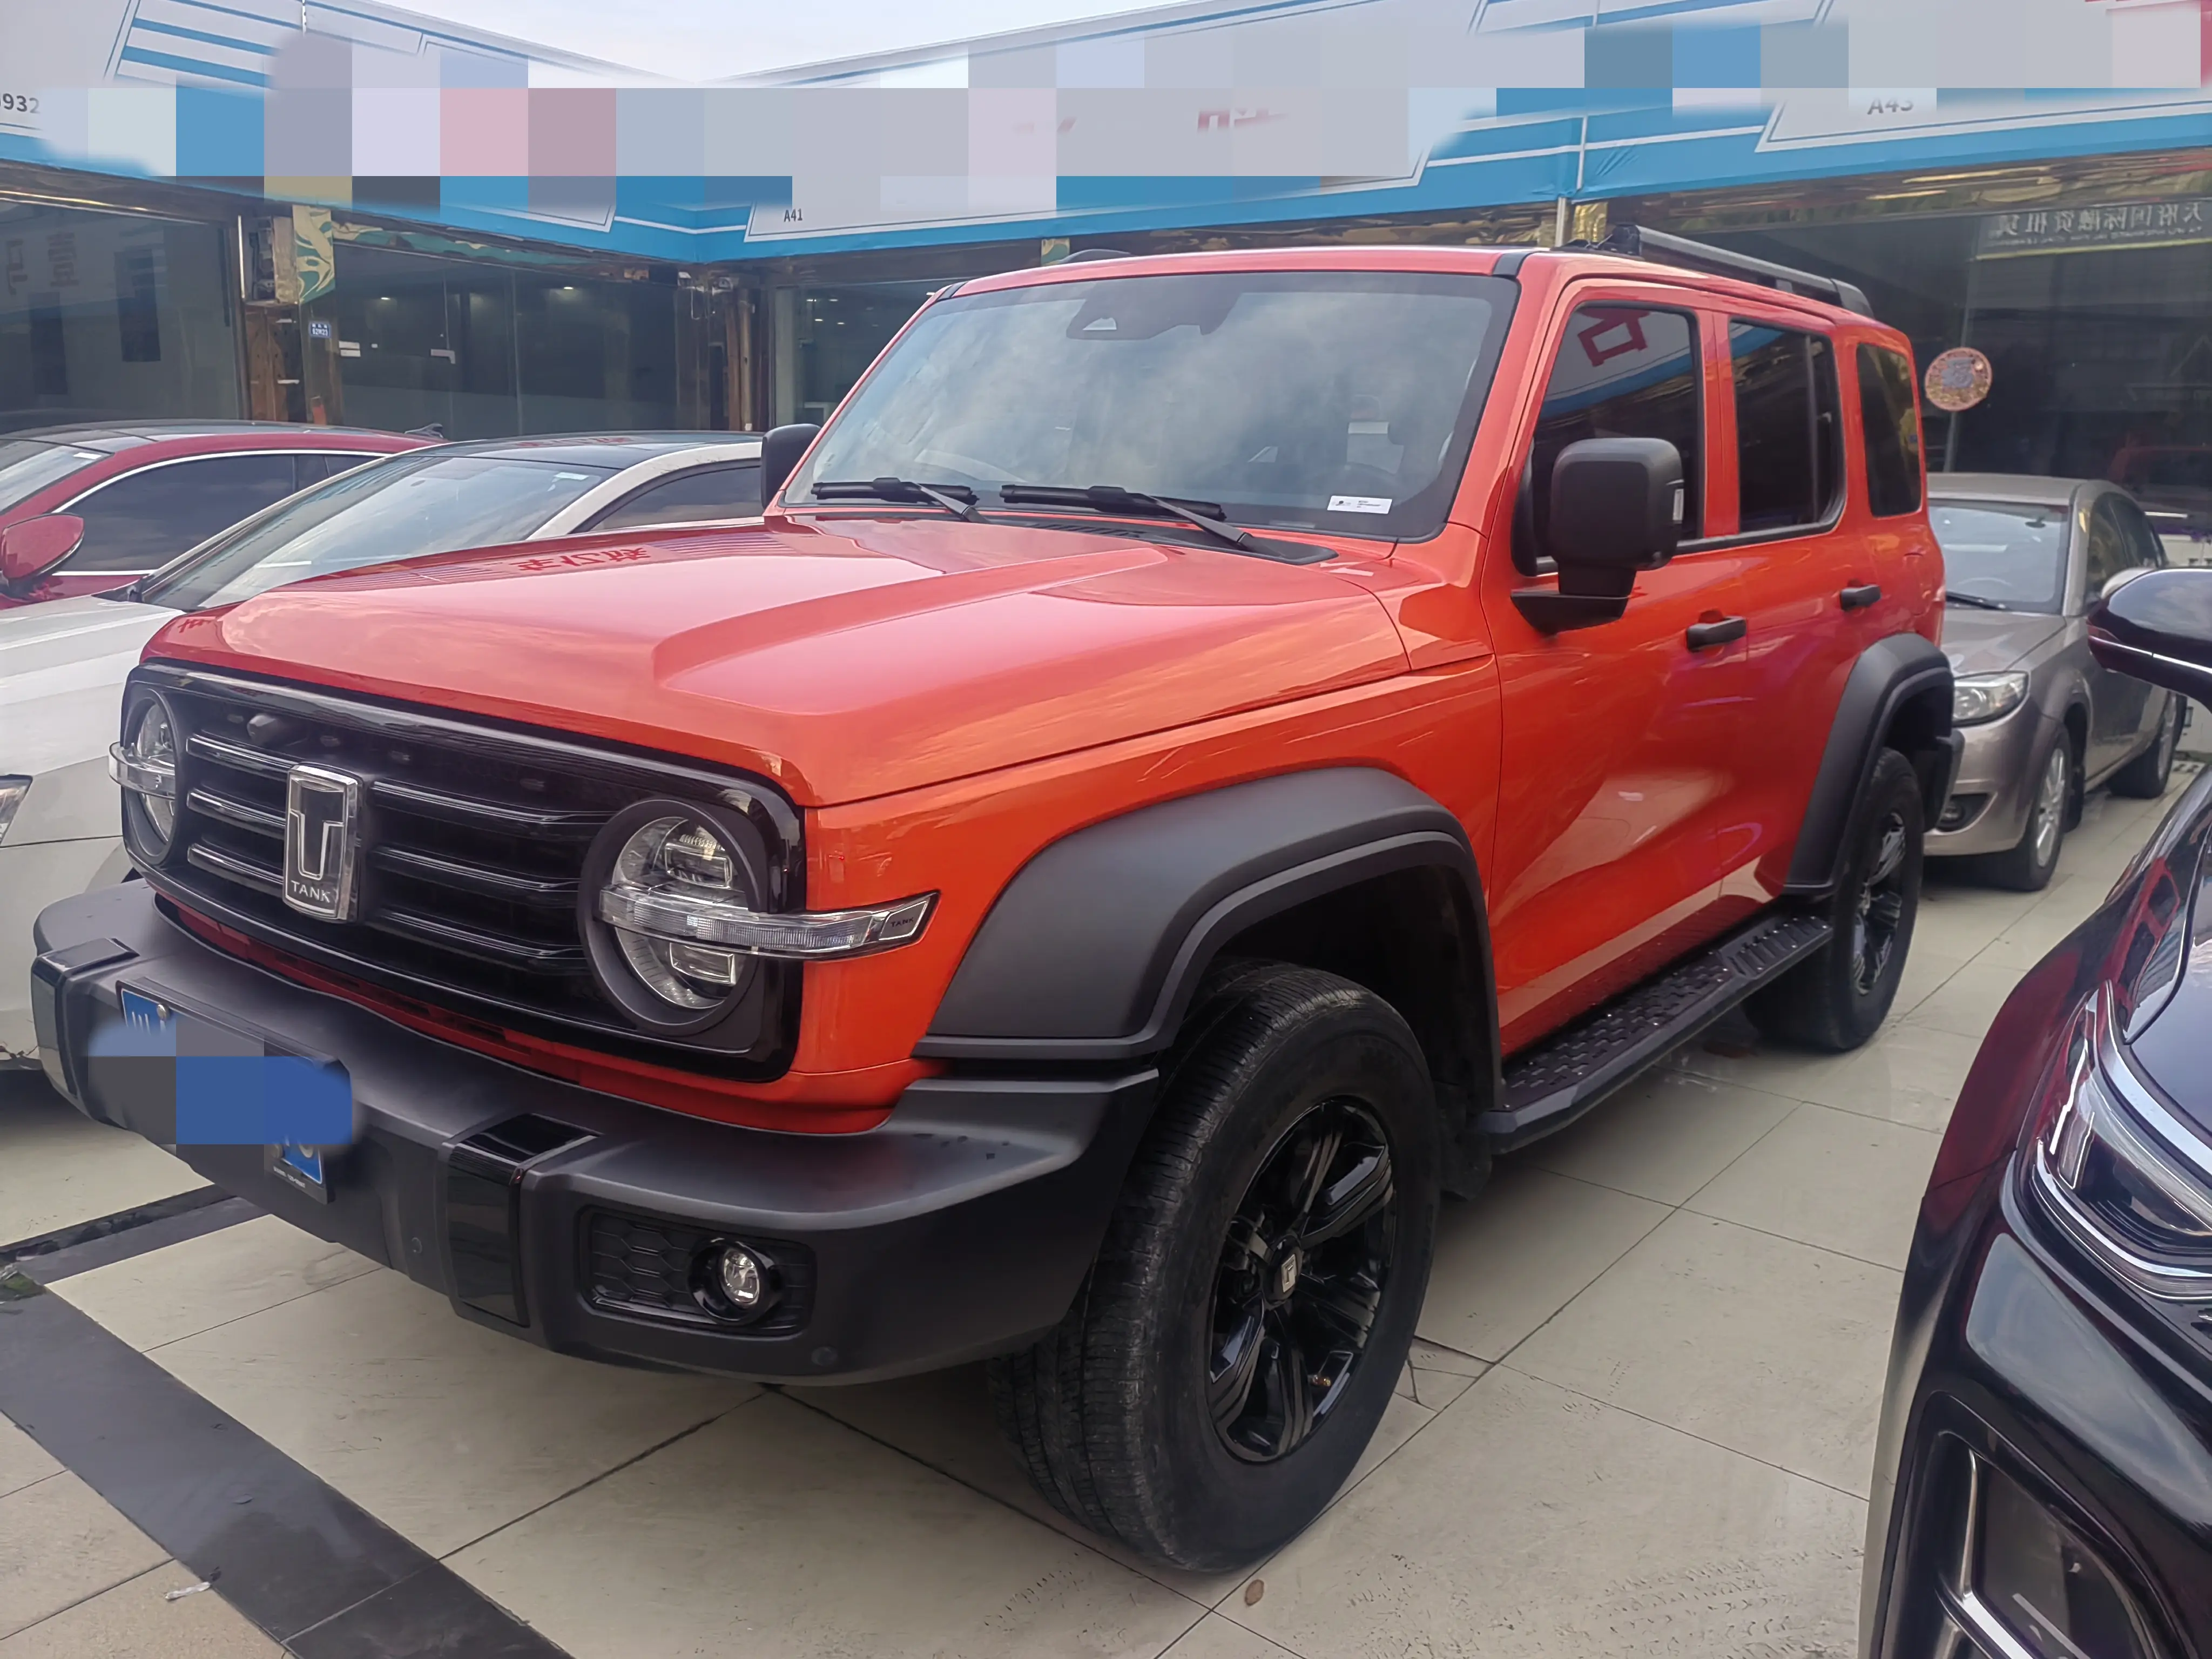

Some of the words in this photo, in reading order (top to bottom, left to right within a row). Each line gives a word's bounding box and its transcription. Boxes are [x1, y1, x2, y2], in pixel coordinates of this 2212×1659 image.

[0, 92, 41, 114] 932
[784, 208, 803, 222] A41
[290, 880, 331, 903] TANK
[891, 916, 914, 928] TANK
